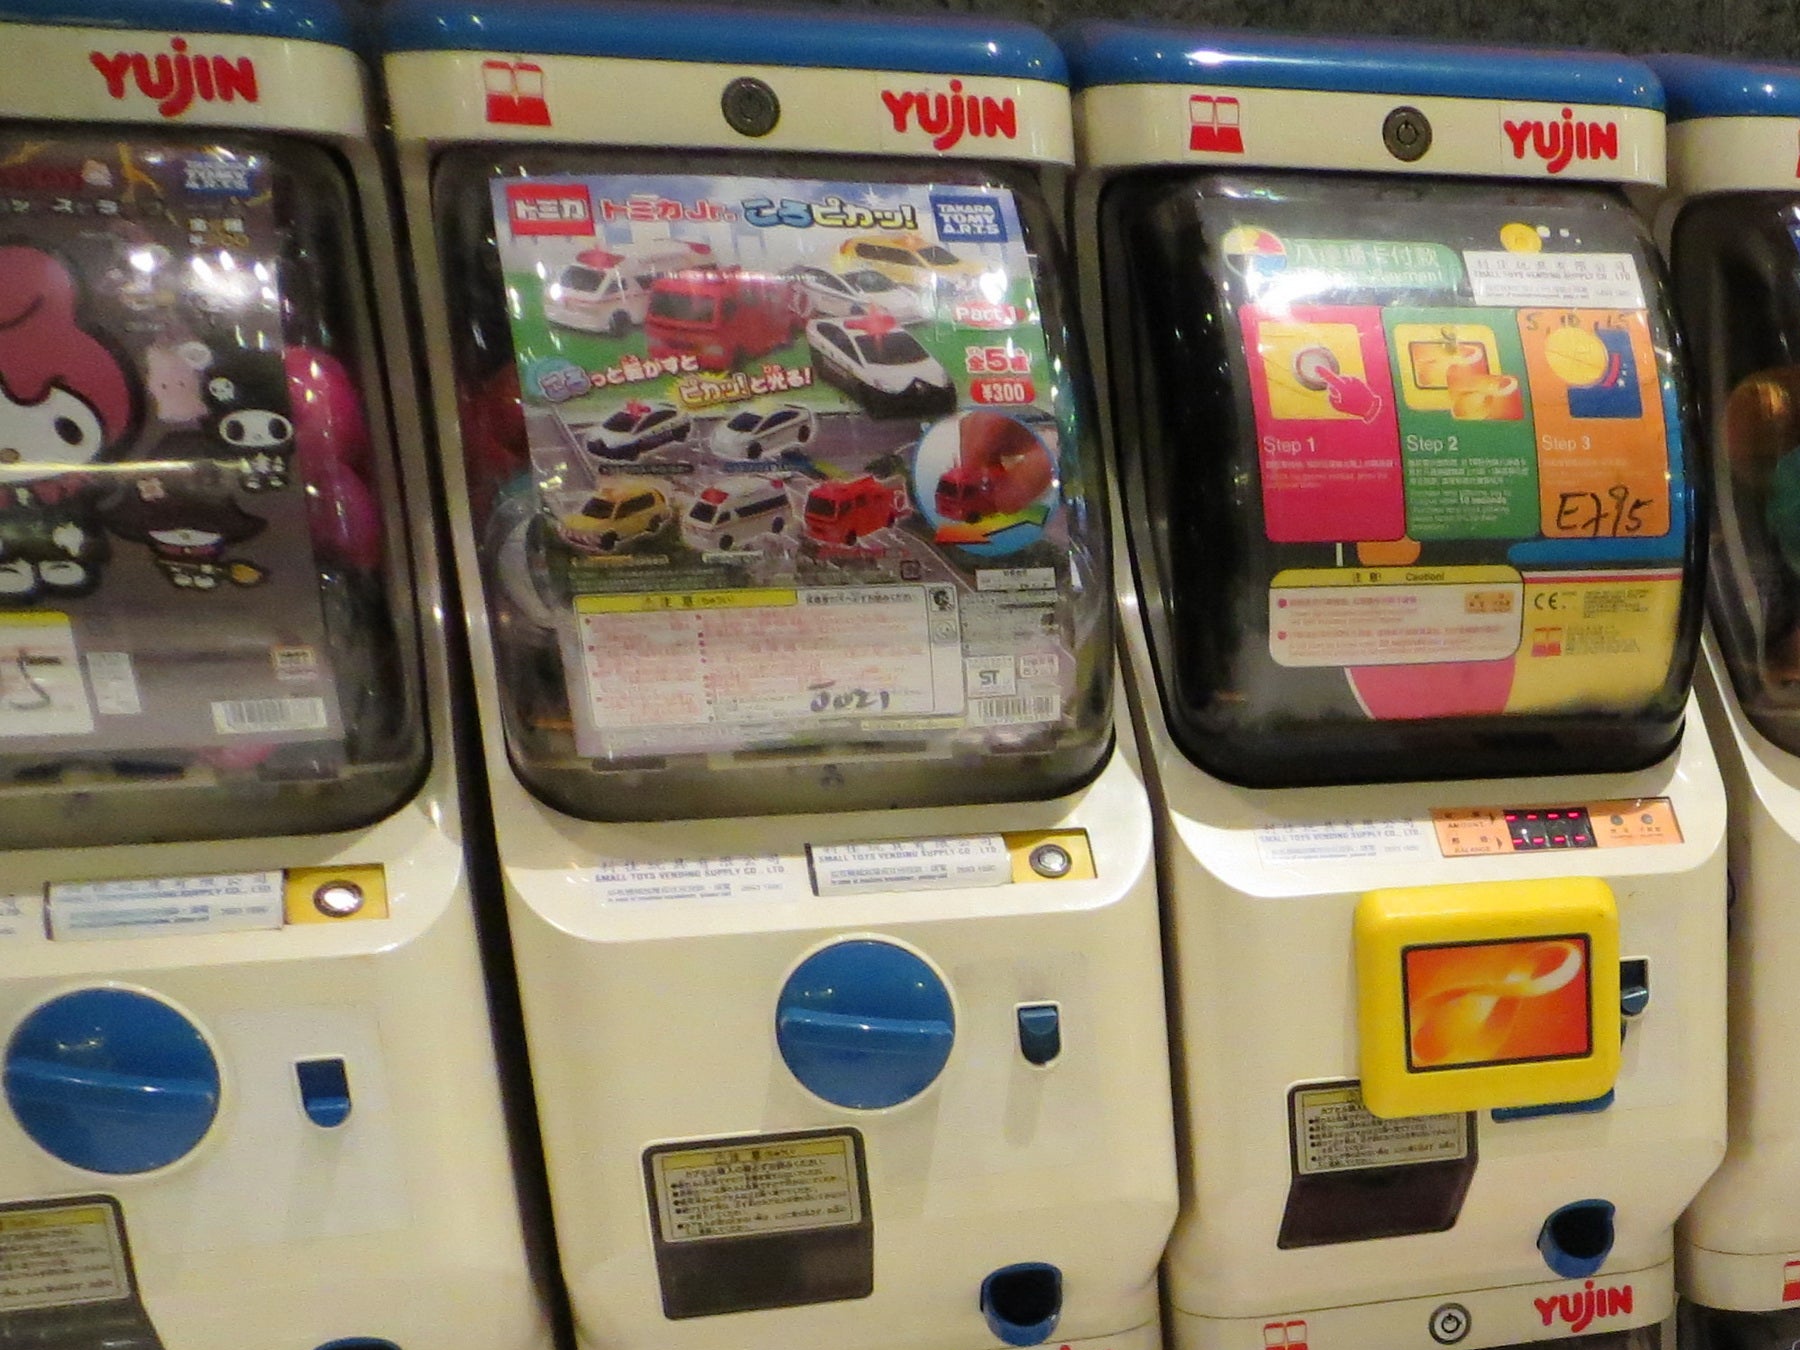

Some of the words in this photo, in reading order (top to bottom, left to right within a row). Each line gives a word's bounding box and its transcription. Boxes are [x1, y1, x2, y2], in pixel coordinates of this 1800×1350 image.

[514, 198, 588, 221] トミカ
[940, 213, 995, 225] TOMY
[982, 383, 1025, 402] ¥300
[1263, 436, 1302, 456] Step
[1306, 439, 1316, 453] 1
[1406, 435, 1444, 456] Step
[1448, 437, 1459, 451] 2
[1542, 436, 1579, 456] Step
[1582, 437, 1591, 451] 3
